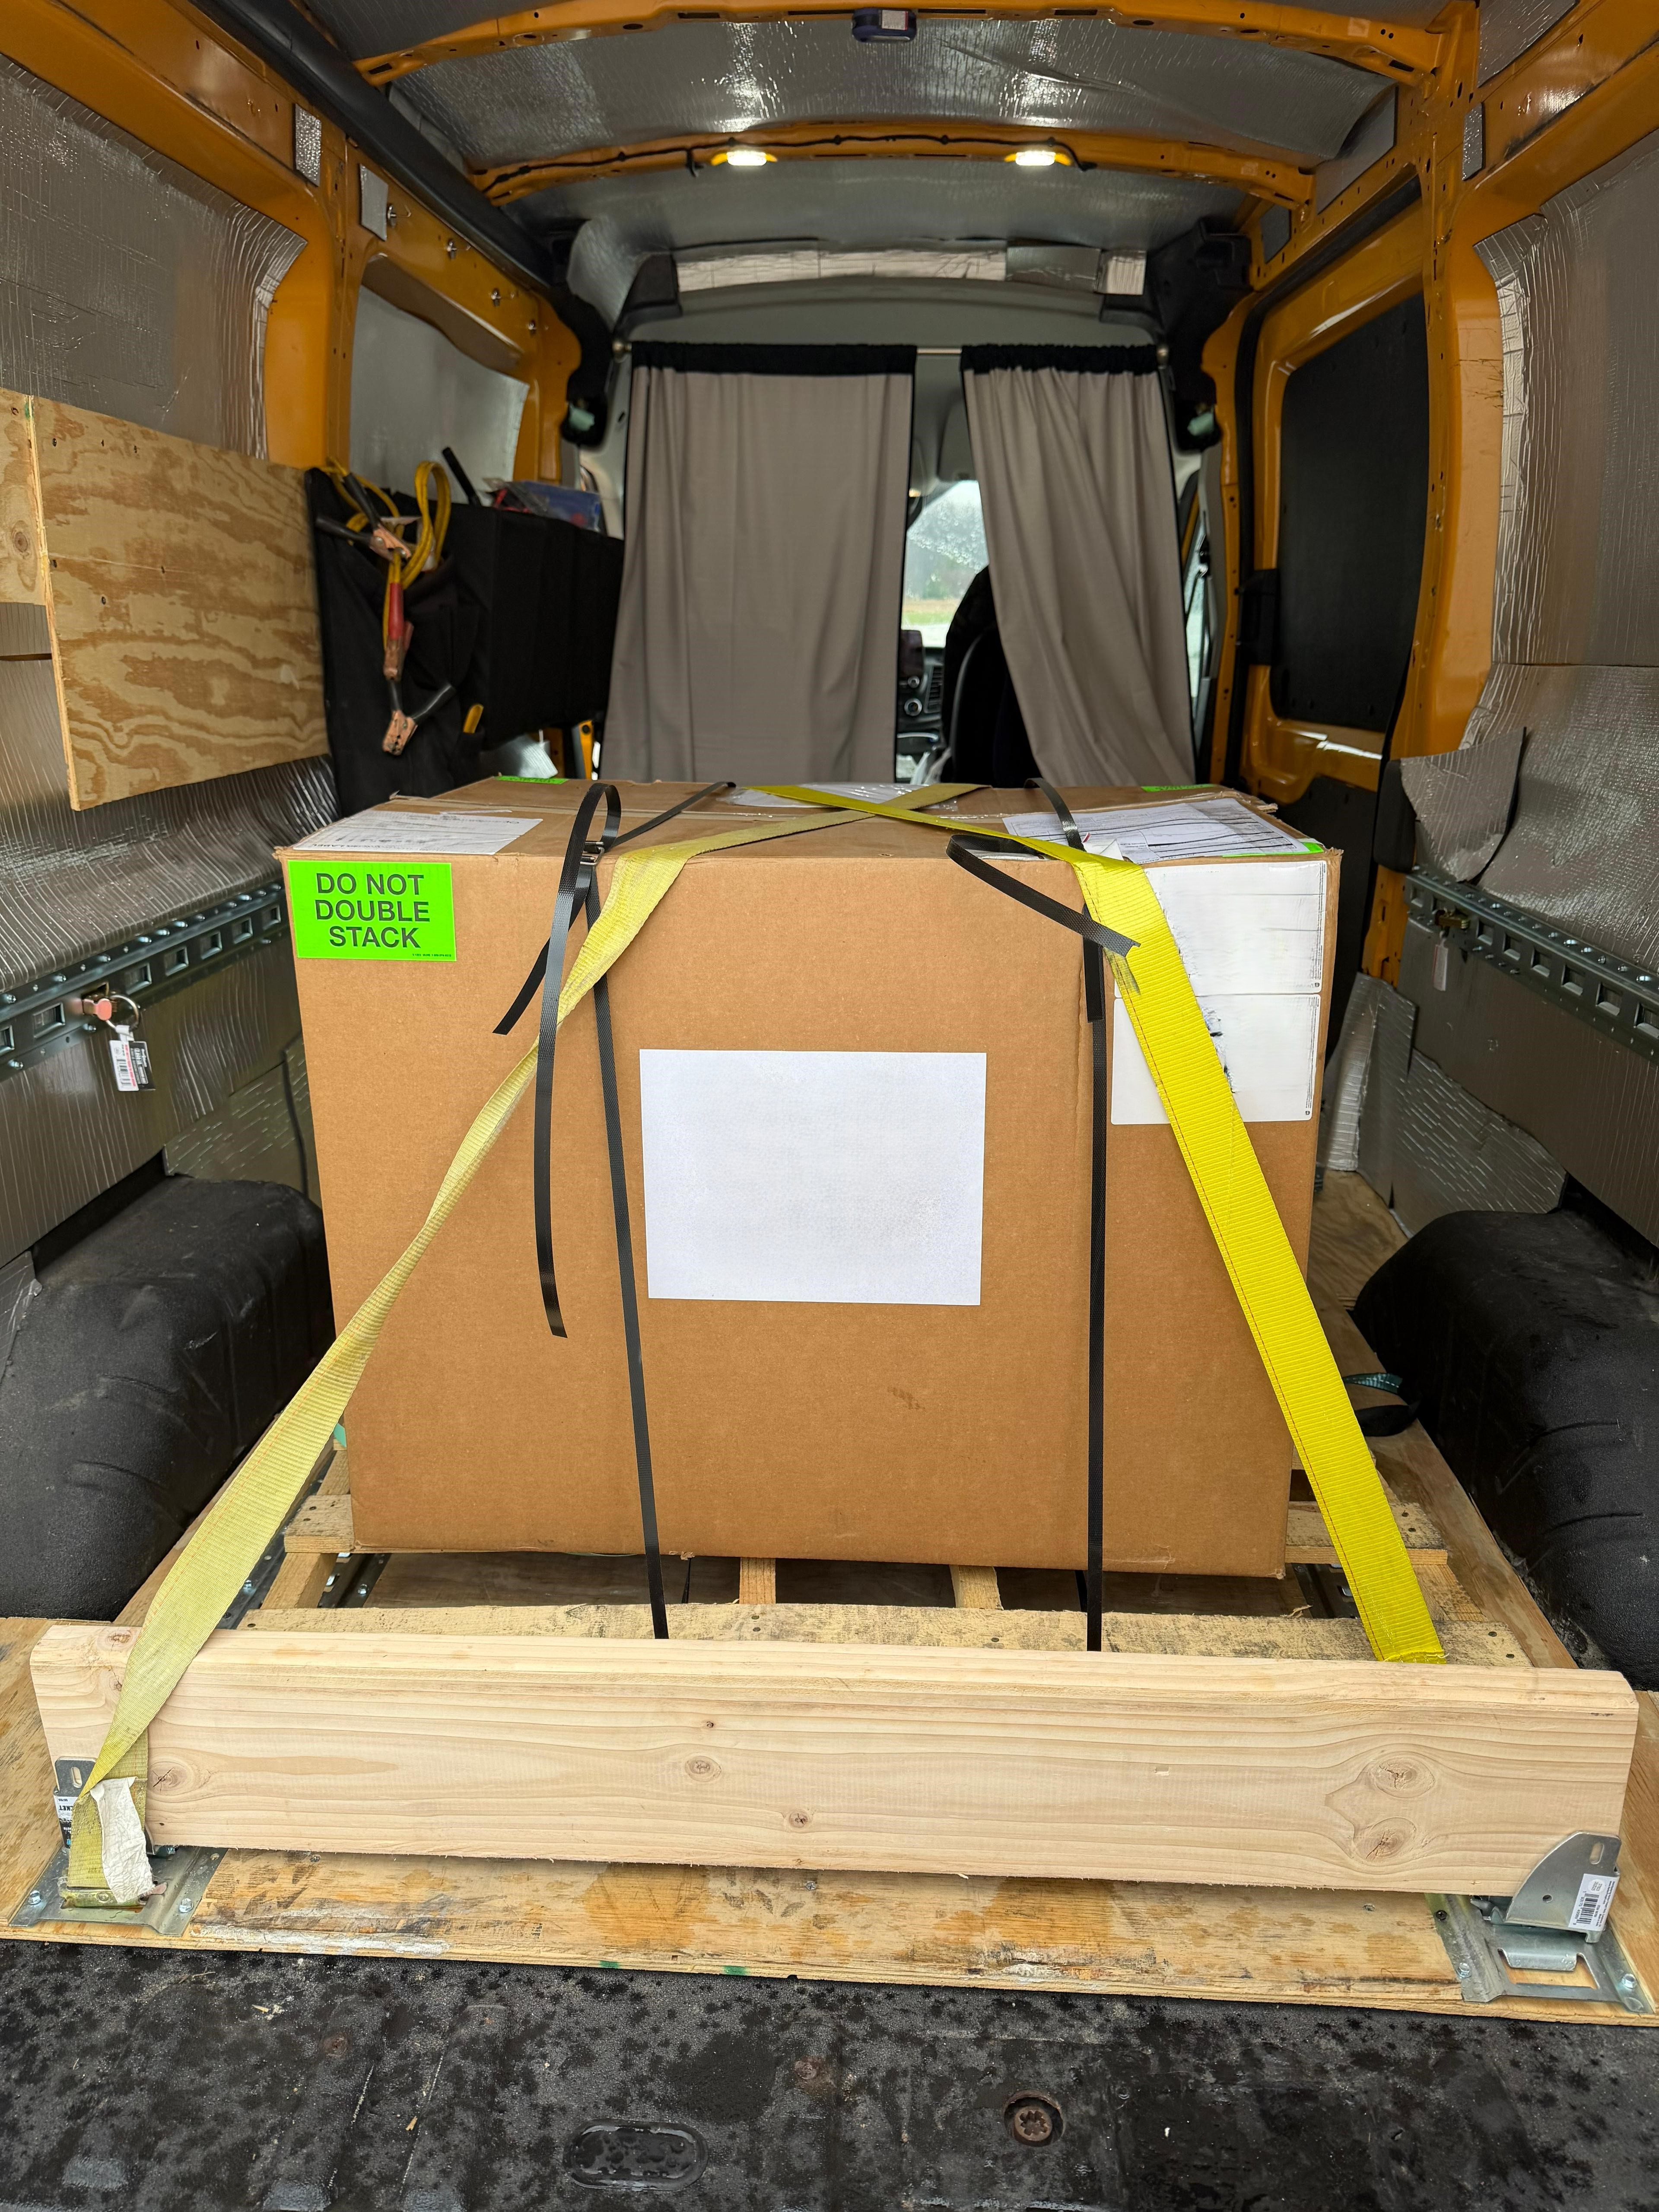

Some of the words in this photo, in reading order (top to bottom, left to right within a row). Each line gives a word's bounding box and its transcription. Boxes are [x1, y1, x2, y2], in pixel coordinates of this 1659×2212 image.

[316, 873, 356, 894] DO
[366, 874, 424, 895] NOT
[315, 899, 430, 922] DOUBLE
[330, 926, 420, 948] STACK
